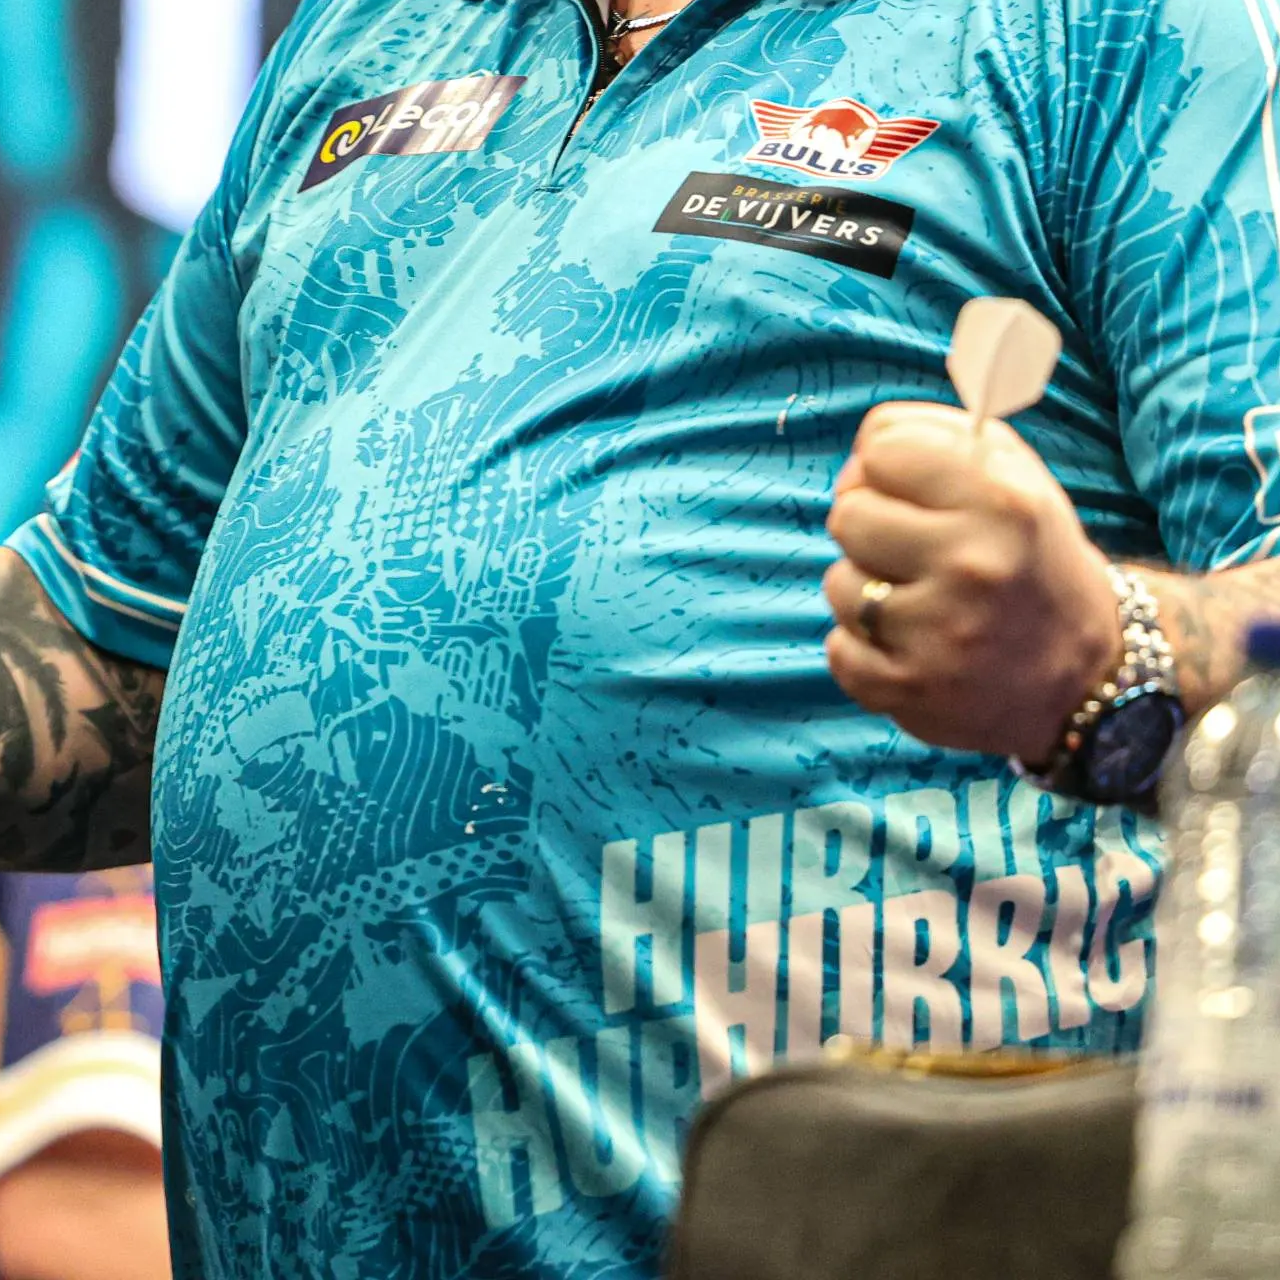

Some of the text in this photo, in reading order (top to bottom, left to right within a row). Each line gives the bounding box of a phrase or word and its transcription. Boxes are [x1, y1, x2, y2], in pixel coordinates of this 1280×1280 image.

[757, 142, 878, 176] BULL'S
[732, 185, 848, 215] BRASSERIE
[681, 194, 885, 246] DE VIJVERS
